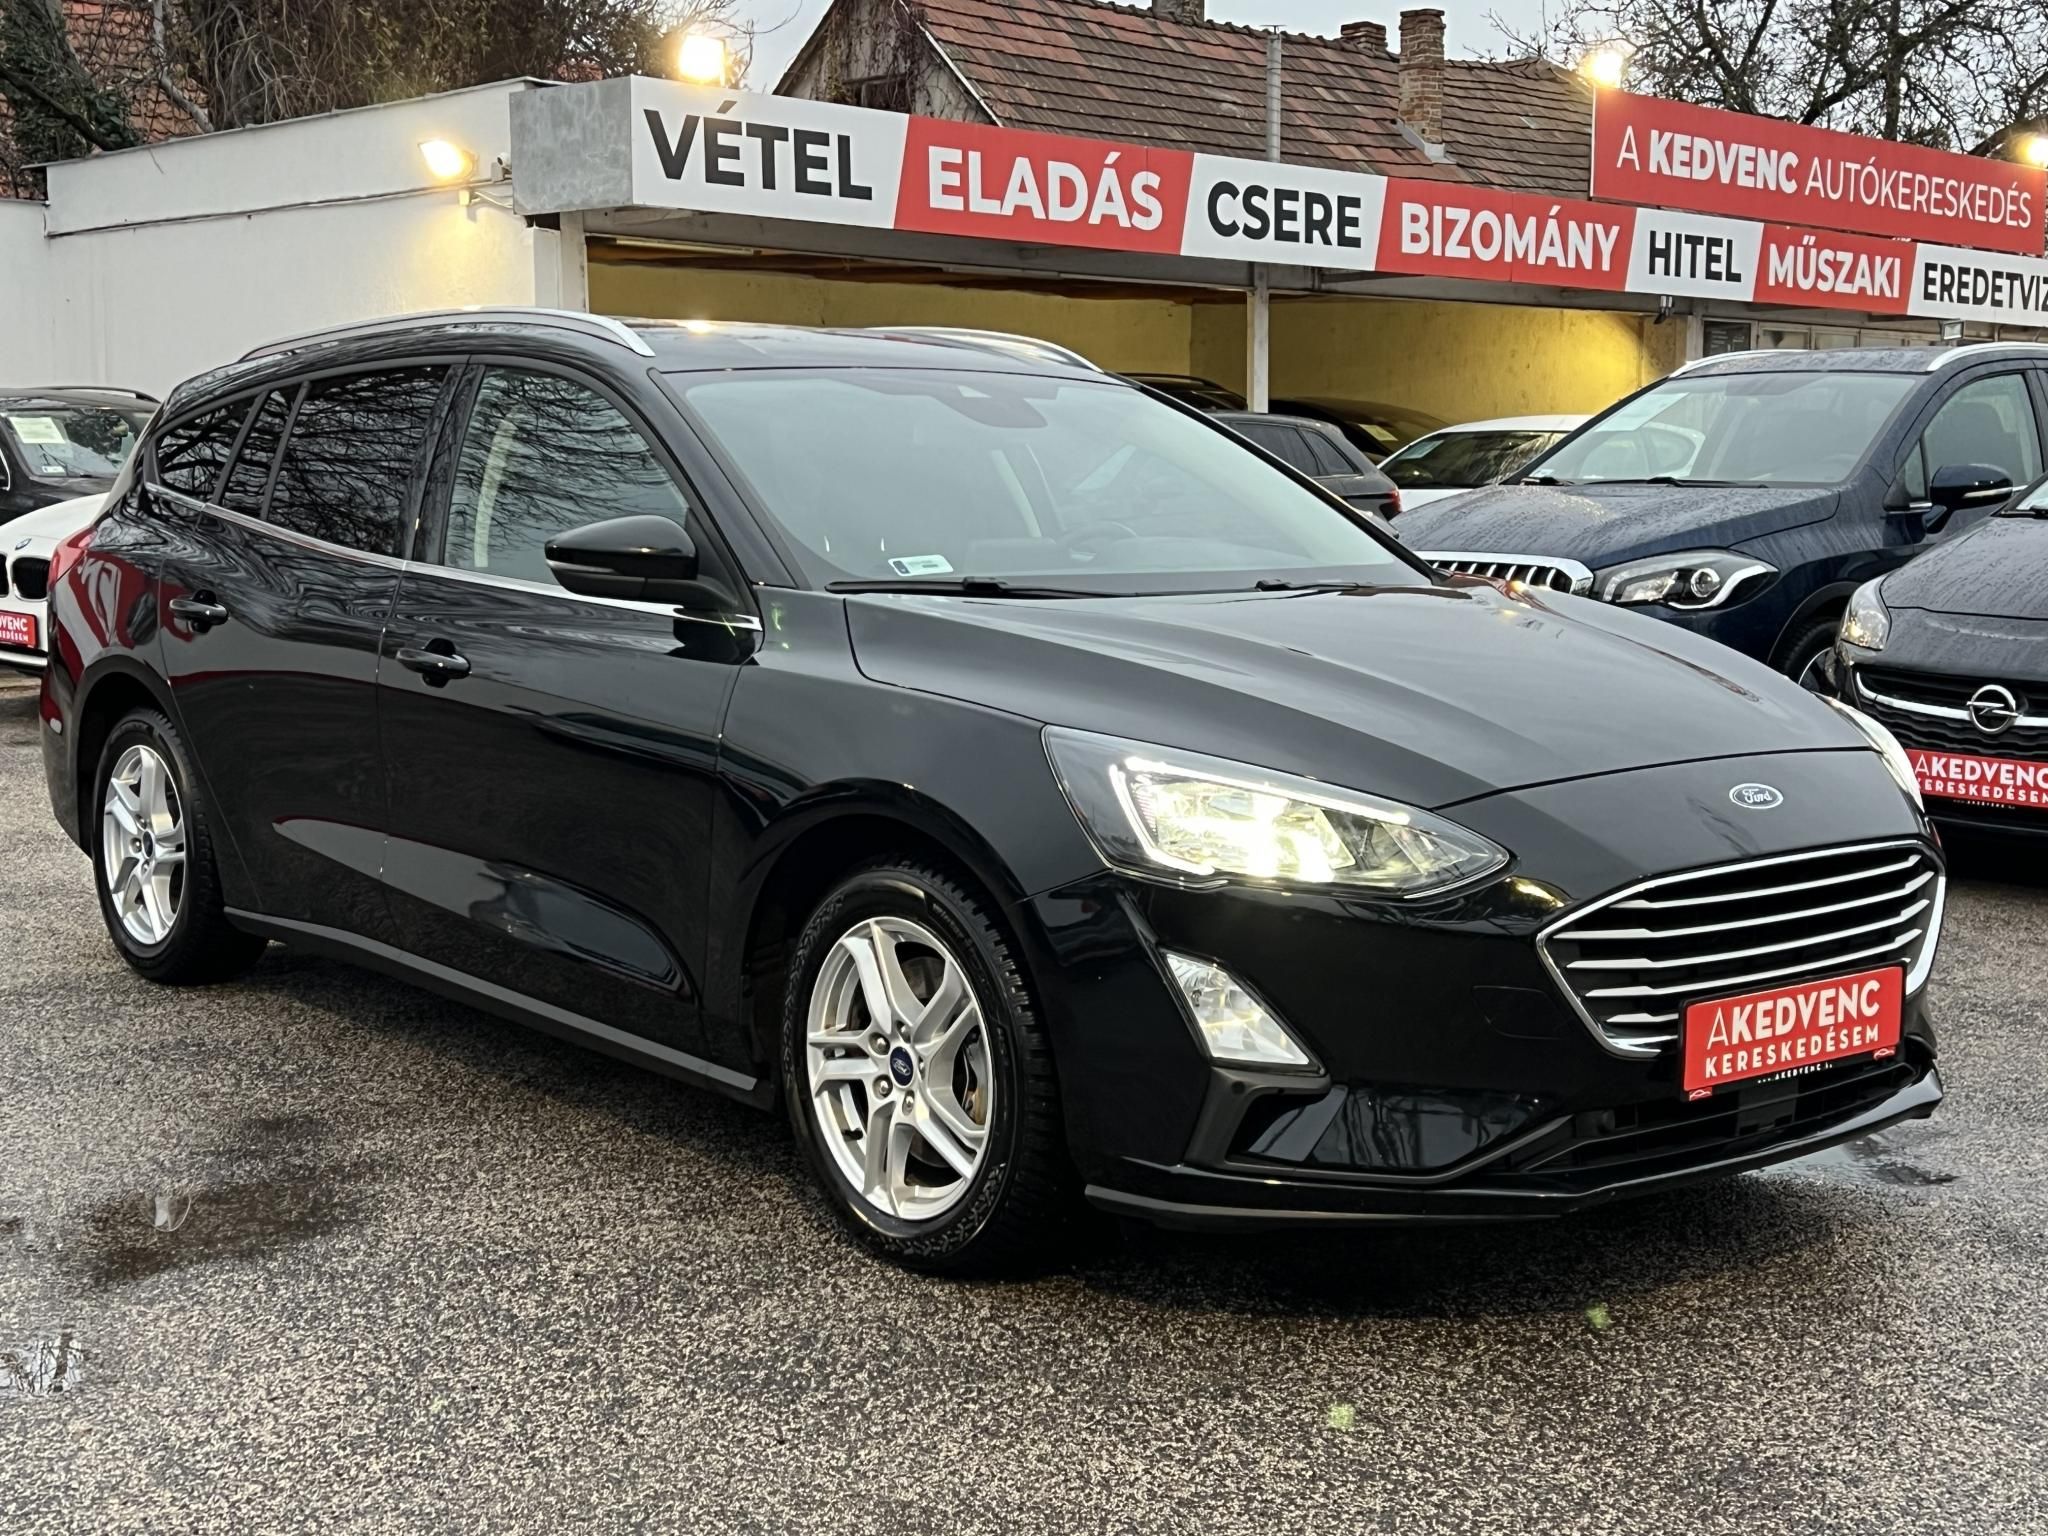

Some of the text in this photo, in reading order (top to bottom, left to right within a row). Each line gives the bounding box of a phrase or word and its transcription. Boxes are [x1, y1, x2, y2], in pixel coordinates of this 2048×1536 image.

[643, 100, 873, 202] VÉTEL
[1616, 125, 2032, 228] A KEDVENC AUTÓKERESKEDÉS
[928, 145, 1164, 232] ELADÁS
[1207, 179, 1363, 250] CSERE
[1401, 201, 1620, 272] BIZOMÁNY
[1648, 231, 1742, 284] HITEL
[1769, 235, 1900, 298] MŰSZAKI
[1742, 788, 1773, 804] Ford
[1705, 1023, 1879, 1079] KERESKEDÉSEM
